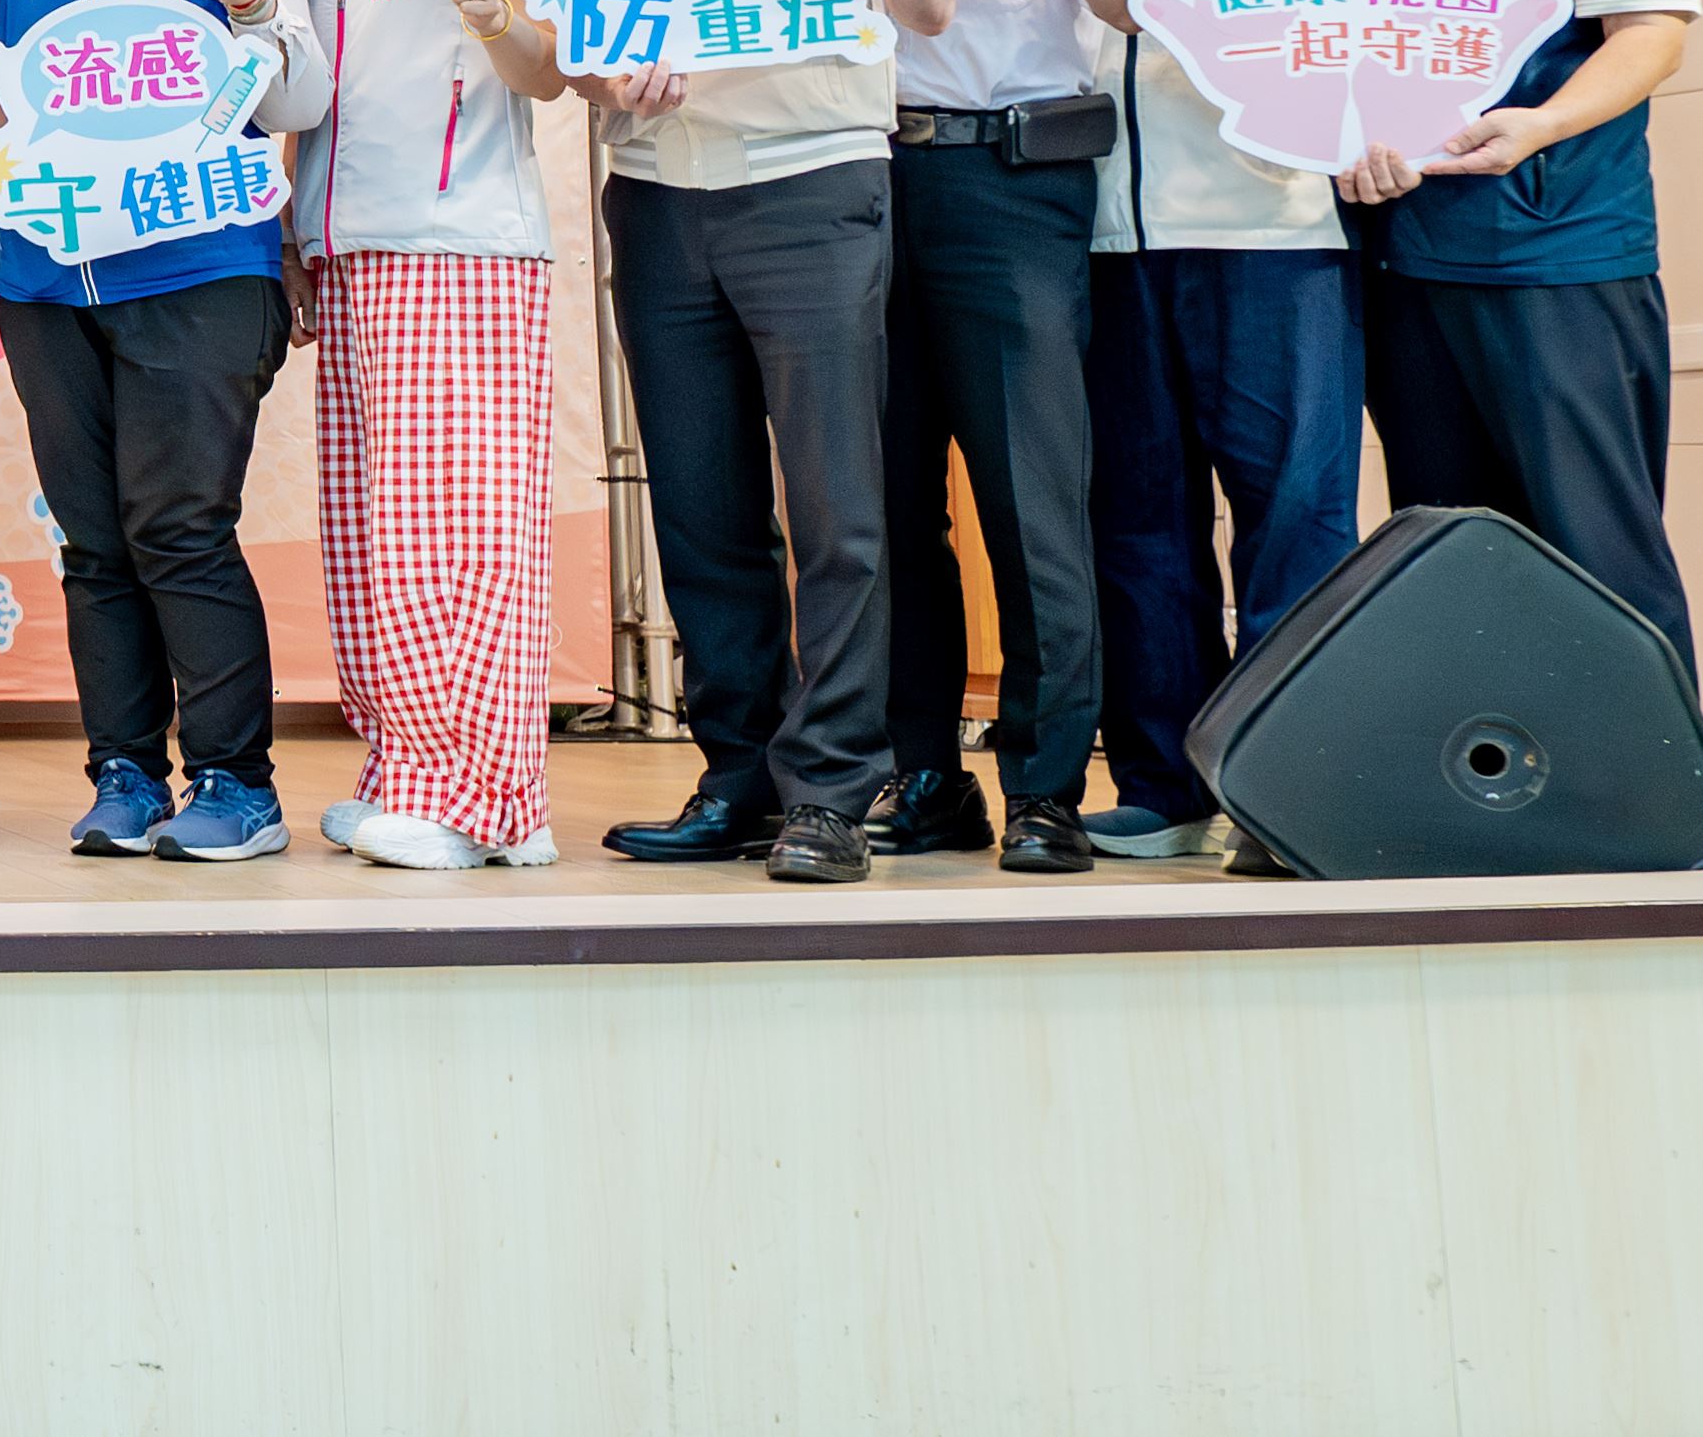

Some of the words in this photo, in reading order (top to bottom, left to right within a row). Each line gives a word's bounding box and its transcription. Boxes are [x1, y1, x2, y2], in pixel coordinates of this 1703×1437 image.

[1223, 20, 1497, 80] 一起守護
[4, 145, 269, 254] 守健康
